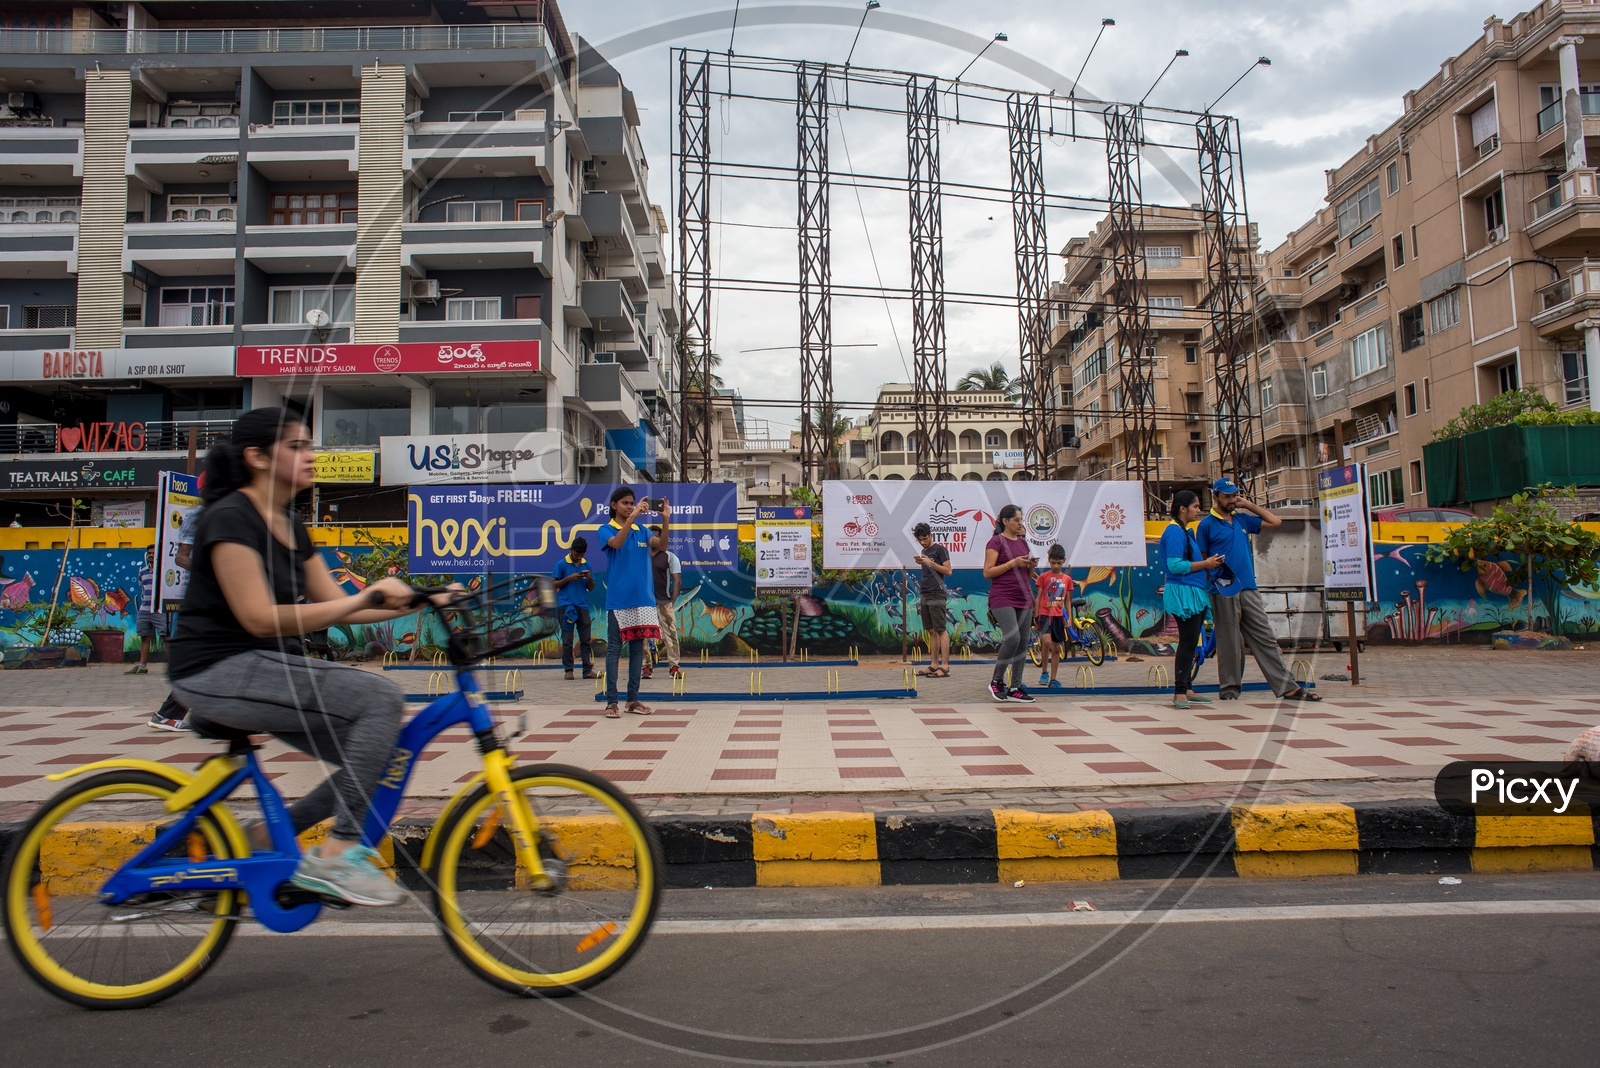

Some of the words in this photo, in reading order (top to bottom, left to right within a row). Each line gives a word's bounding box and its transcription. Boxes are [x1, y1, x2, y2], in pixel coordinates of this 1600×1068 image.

[257, 347, 337, 364] TRENDS
[42, 351, 103, 378] BARISTA
[127, 366, 133, 376] A
[135, 366, 146, 376] SIP
[148, 365, 158, 375] OR
[160, 365, 165, 375] A
[166, 364, 186, 374] SHOT
[80, 421, 146, 452] VIZAG
[407, 443, 451, 471] US
[460, 443, 534, 470] Shoppe
[103, 467, 136, 481] CAFÉ
[430, 495, 445, 504] GET
[446, 495, 467, 503] FIRST
[497, 490, 542, 503] FREE!!!
[1333, 505, 1337, 520] 1
[409, 493, 510, 557] hexi
[775, 531, 780, 541] 1
[933, 533, 949, 542] ITY
[953, 532, 966, 542] OF
[1324, 534, 1329, 549] 2
[169, 542, 174, 557] 2
[760, 550, 766, 560] 2
[430, 558, 494, 567] www.hexi.co.in
[1332, 560, 1337, 575] 3
[175, 571, 181, 585] 3
[769, 568, 775, 578] 3
